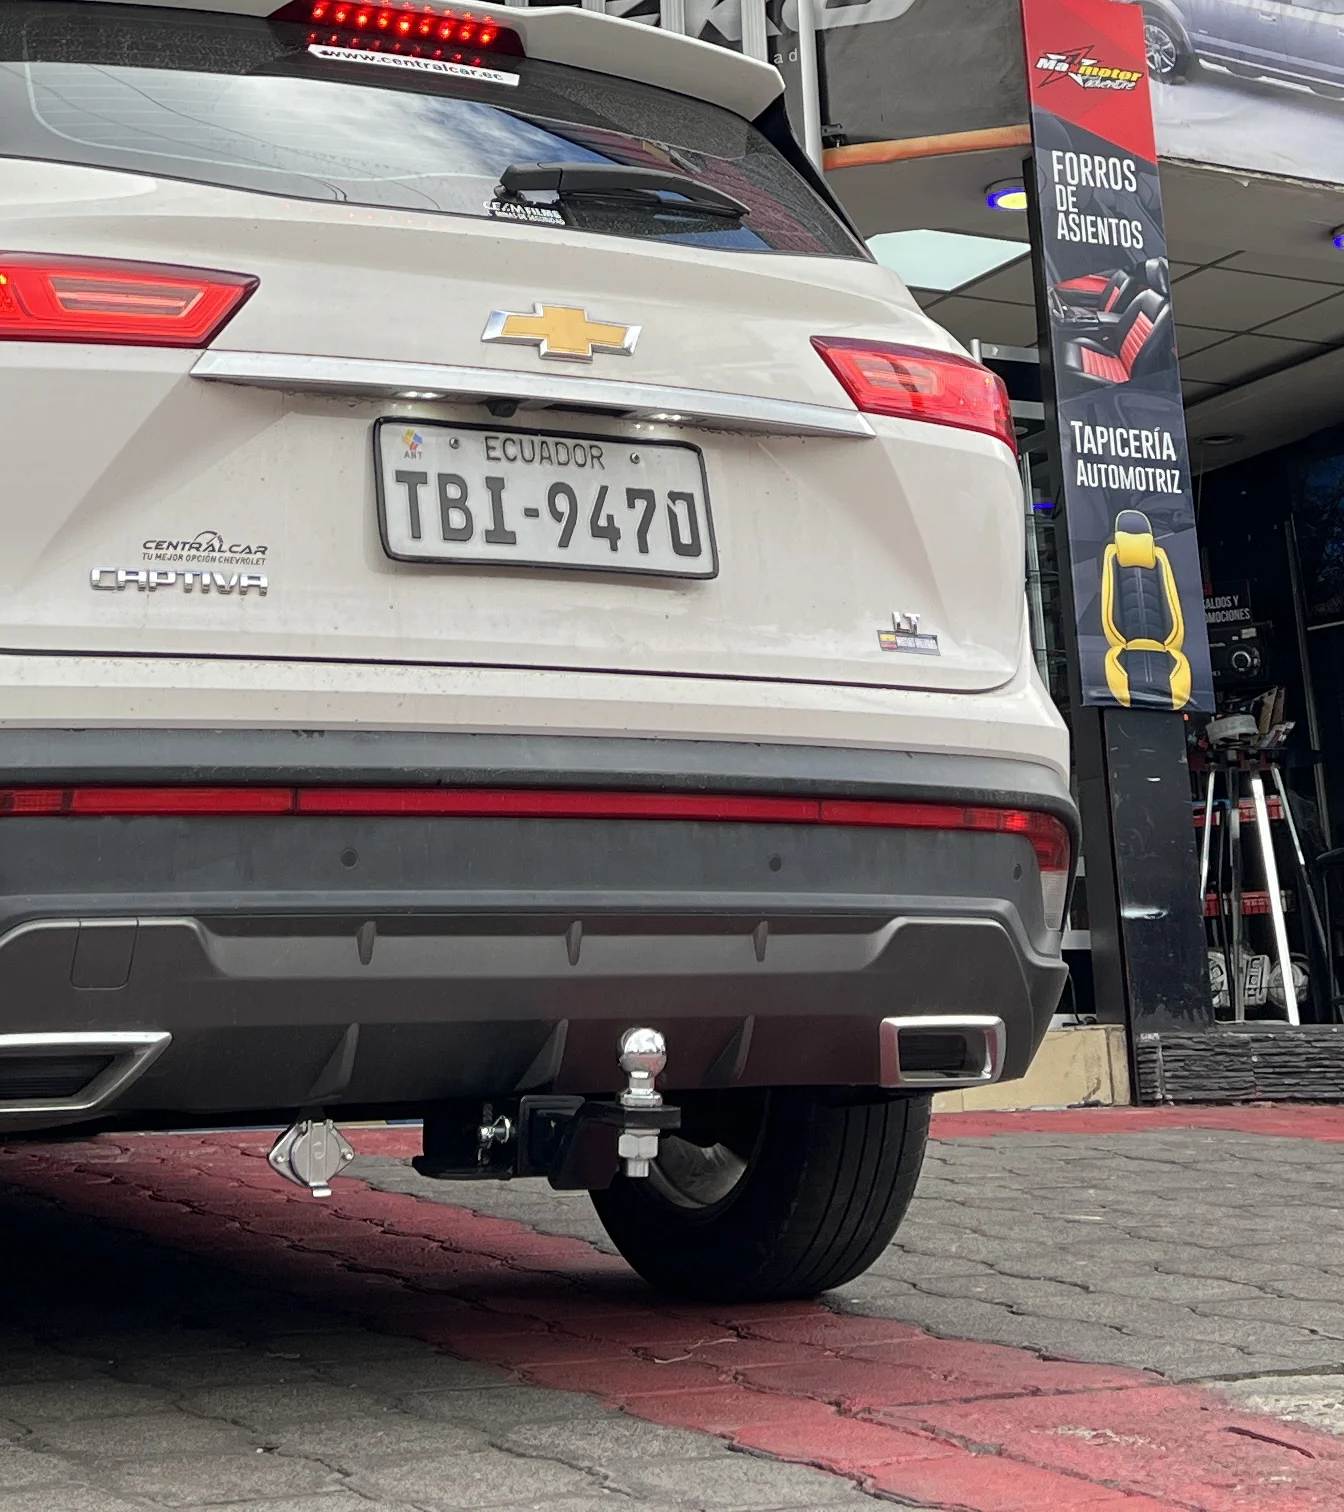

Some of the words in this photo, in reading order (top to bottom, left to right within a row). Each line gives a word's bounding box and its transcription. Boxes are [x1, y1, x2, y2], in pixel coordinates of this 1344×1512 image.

[320, 50, 504, 81] www.centralcar.ec
[1051, 150, 1137, 192] FORROS
[1055, 184, 1078, 213] DE
[1057, 212, 1144, 248] ASIENTOS
[404, 450, 423, 460] ANT
[485, 435, 606, 470] ECUADOR
[1071, 420, 1178, 462] TAPICERÍA
[1077, 459, 1183, 494] AUTOMOTRIZ
[395, 469, 703, 558] TBI-9470
[142, 552, 154, 561] TU
[155, 553, 183, 563] MEJOR
[217, 557, 266, 567] CHEVROLET
[143, 540, 269, 556] CENTRALCAR
[90, 567, 269, 596] CAPTIVA
[1232, 594, 1239, 607] Y
[892, 612, 921, 634] LT
